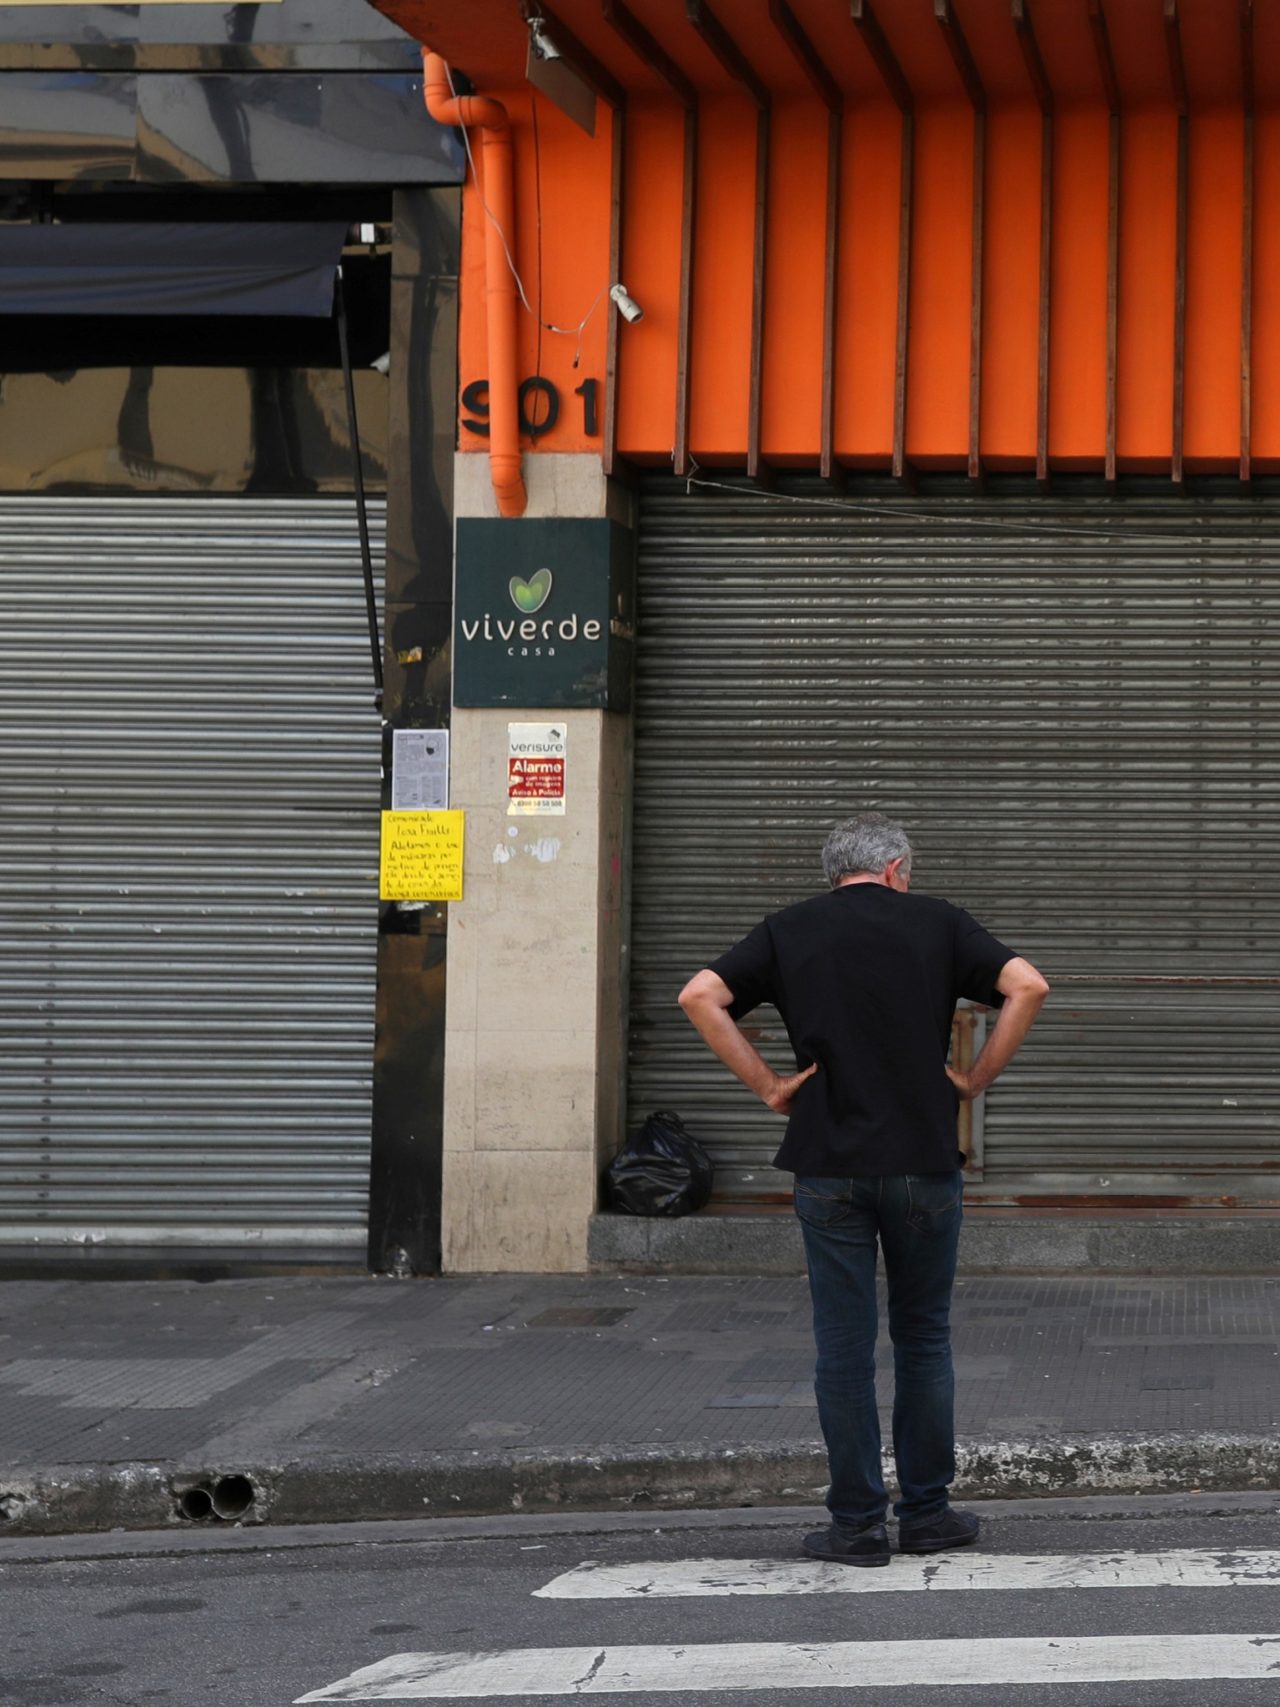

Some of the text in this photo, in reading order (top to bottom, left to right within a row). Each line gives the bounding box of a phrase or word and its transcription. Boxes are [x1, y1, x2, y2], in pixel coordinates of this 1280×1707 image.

[461, 375, 599, 437] 901
[461, 613, 601, 641] viverde
[507, 646, 556, 657] casa
[510, 742, 564, 754] verisure
[512, 759, 562, 773] Alarme
